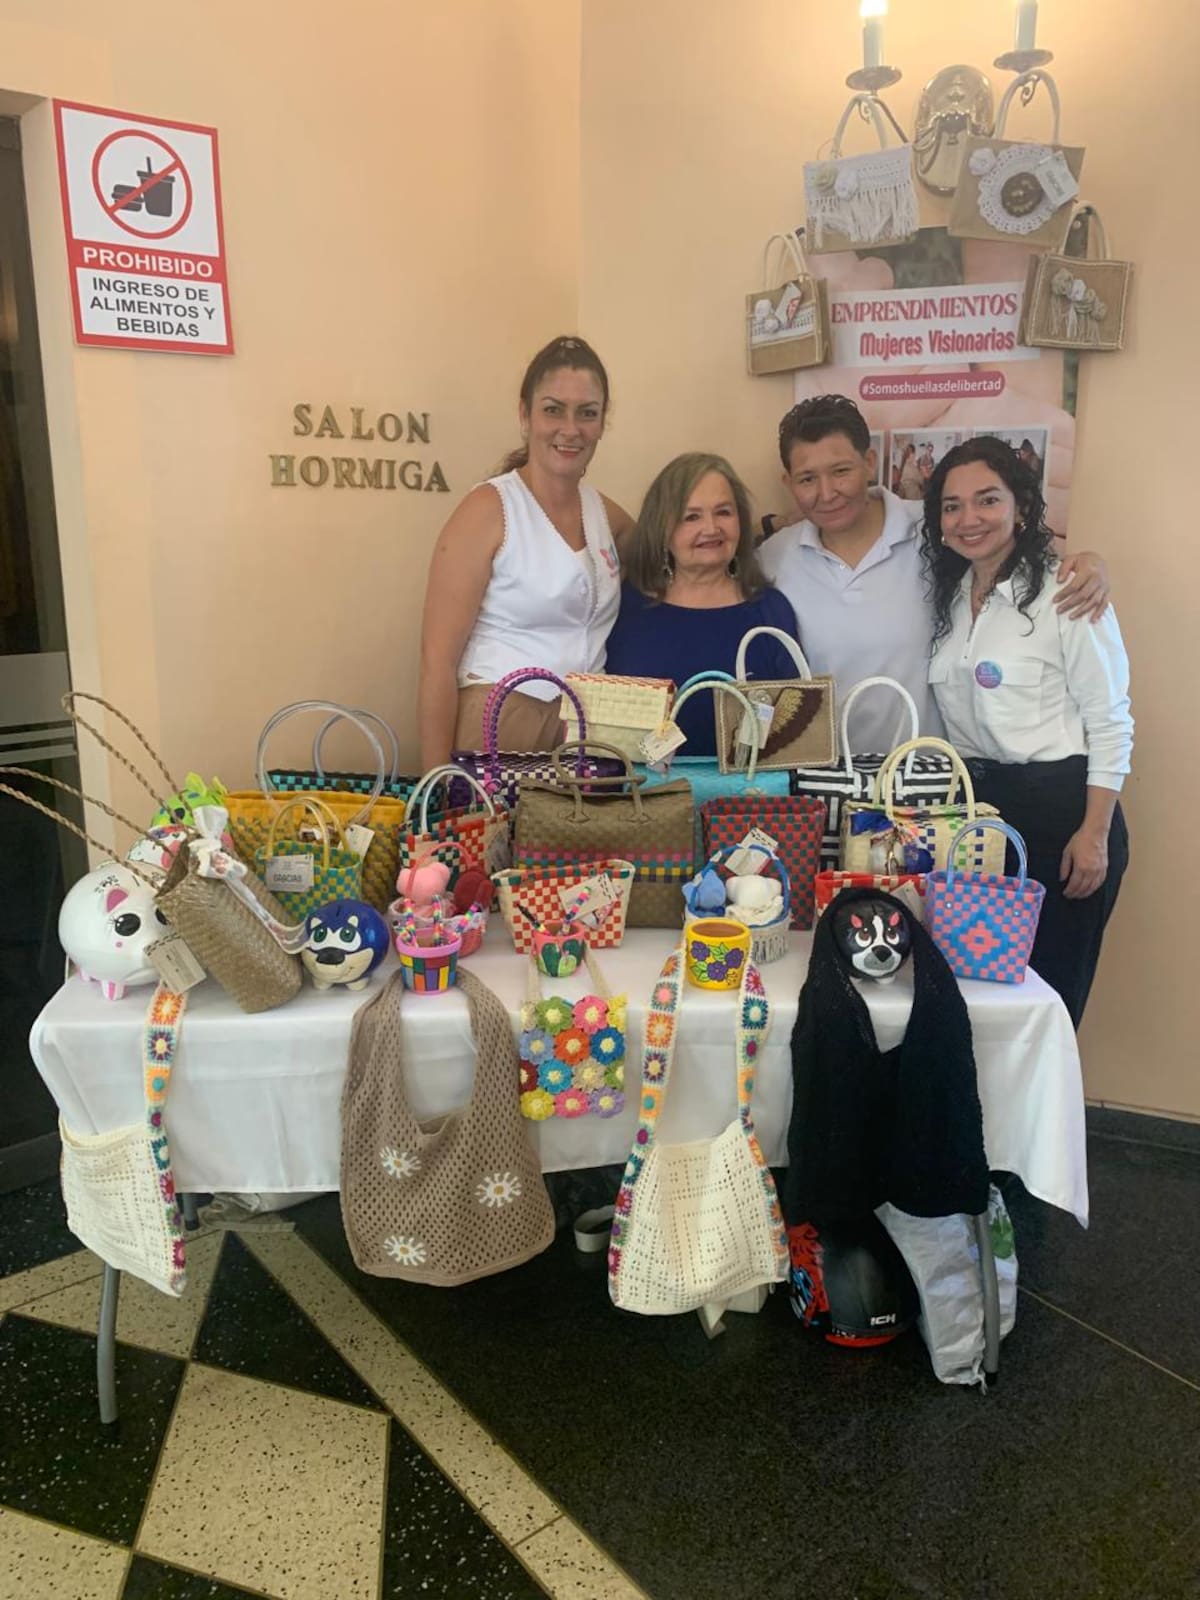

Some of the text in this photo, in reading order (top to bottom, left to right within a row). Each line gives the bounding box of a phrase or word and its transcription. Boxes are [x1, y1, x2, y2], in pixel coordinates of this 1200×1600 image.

[82, 246, 213, 278] PROHIBIDO
[92, 277, 209, 302] INGRESO DE
[90, 296, 216, 320] ALIMENTOS Y
[831, 292, 1018, 324] EMPRENDIMIENTOS
[116, 317, 200, 338] BEBIDAS
[859, 327, 1016, 361] Mujeres Visionarias
[861, 378, 1002, 396] #Somoshuellasdelibertad
[293, 402, 431, 444] SALON
[268, 453, 452, 493] HORMIGA
